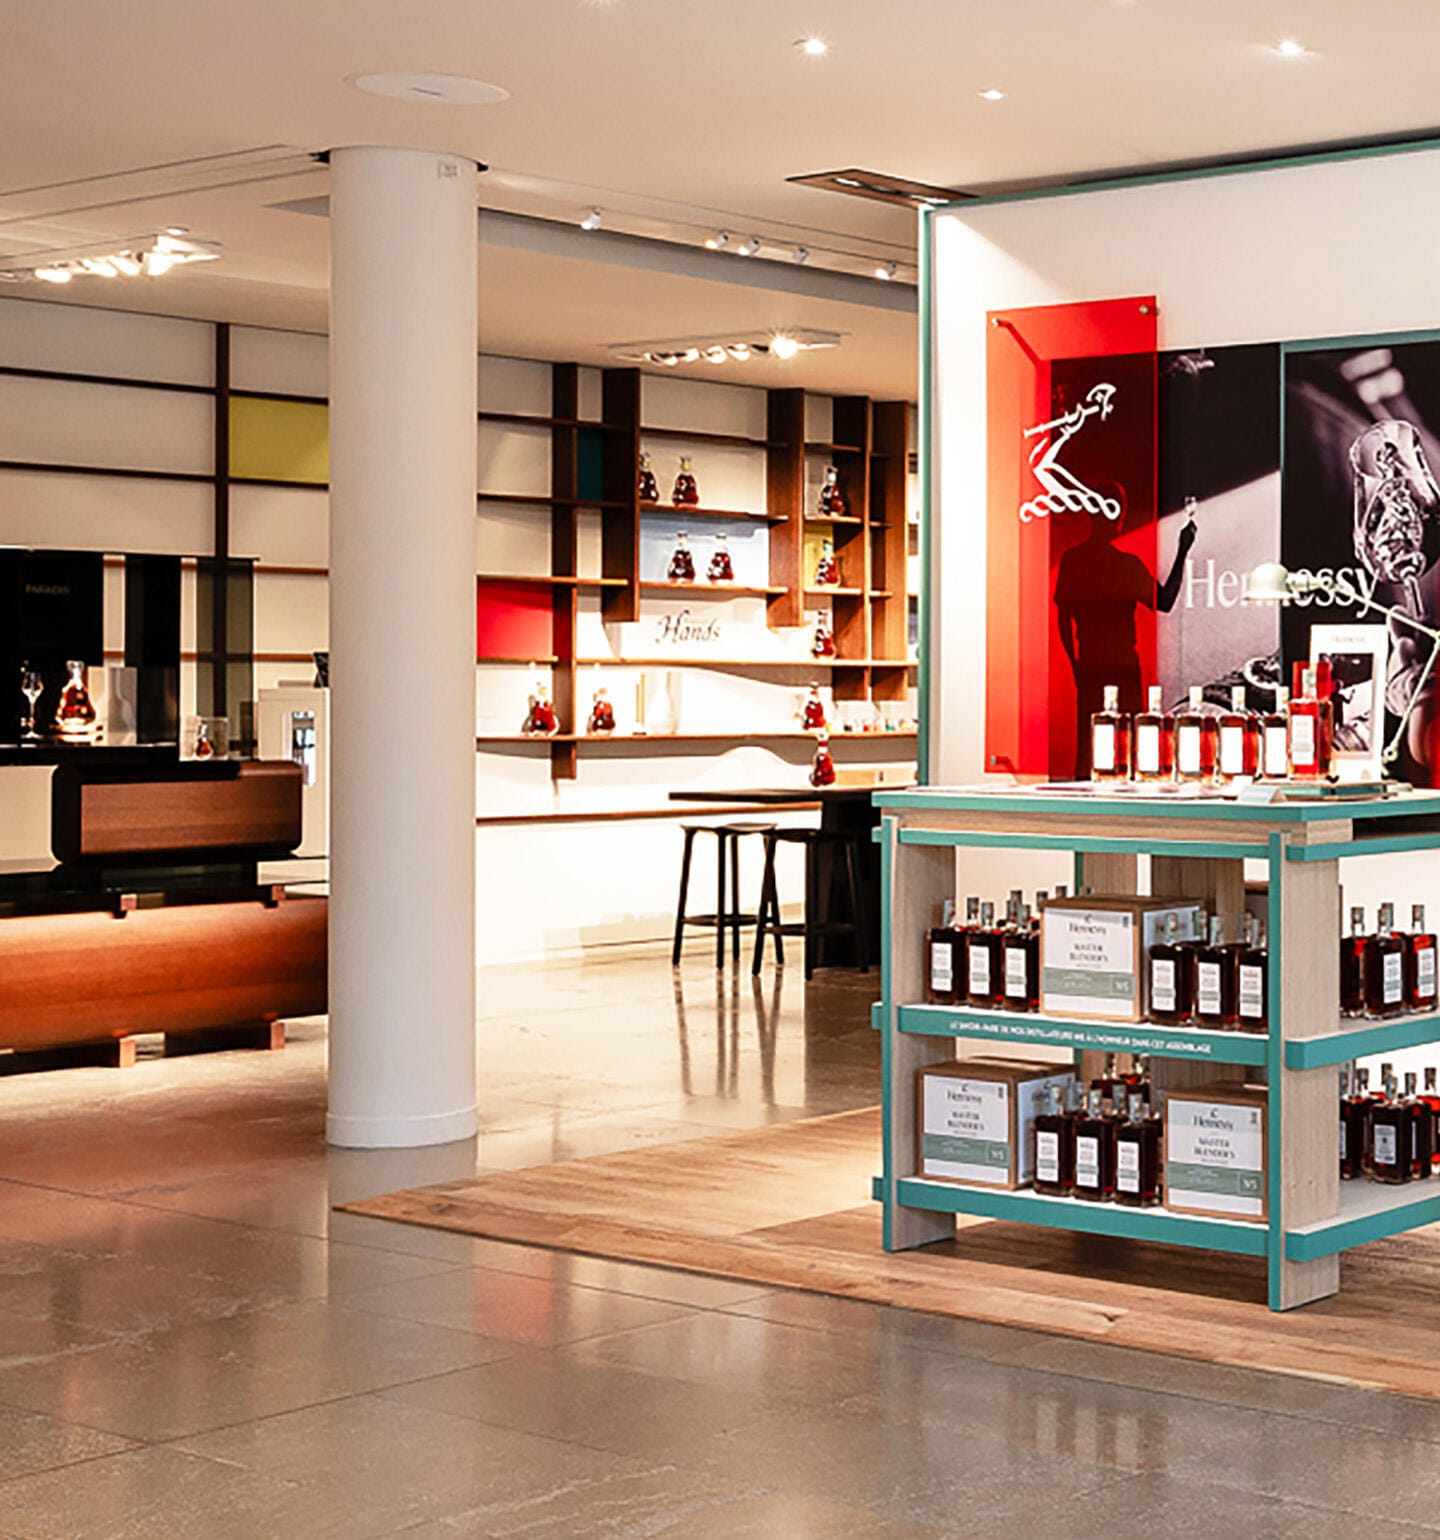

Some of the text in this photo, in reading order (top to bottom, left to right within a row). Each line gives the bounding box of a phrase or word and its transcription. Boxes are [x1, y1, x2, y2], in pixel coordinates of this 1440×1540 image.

[655, 609, 720, 644] Hands
[1166, 1040, 1212, 1054] ASSEMBLAGE
[1193, 1116, 1234, 1131] Hennessy
